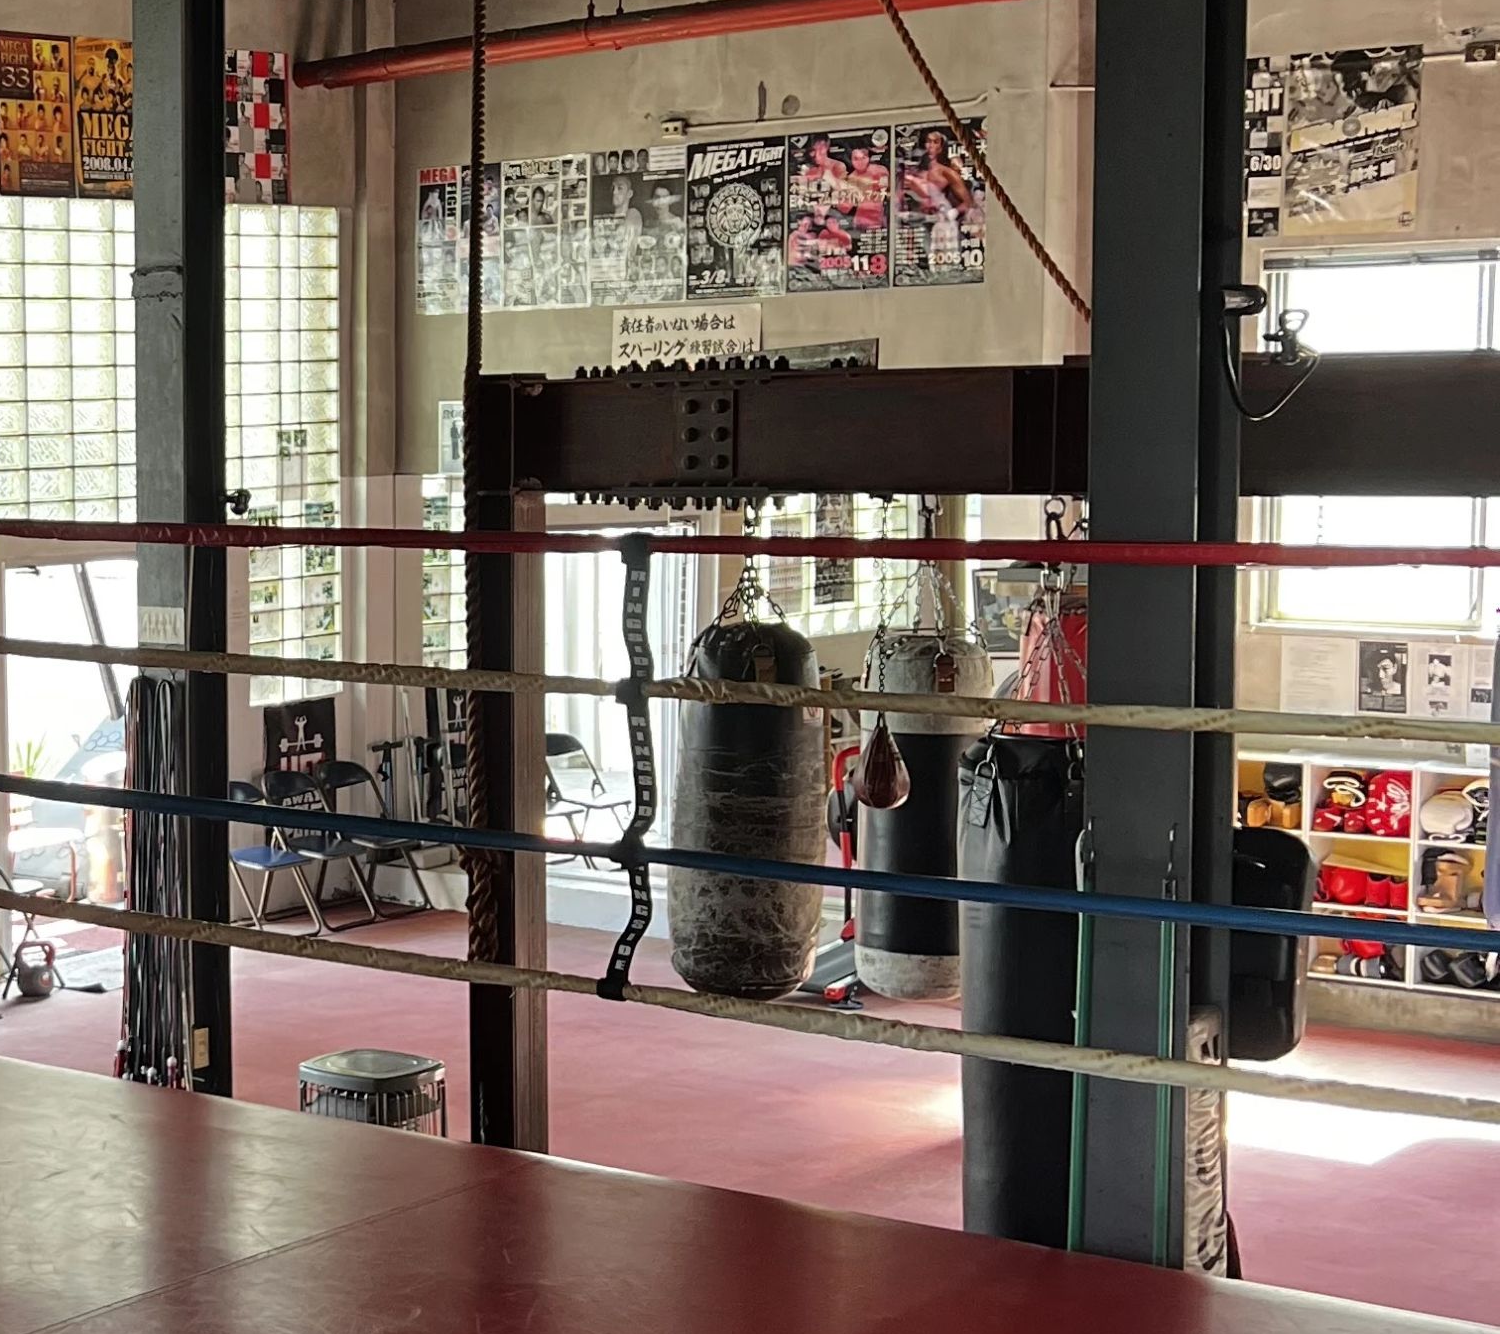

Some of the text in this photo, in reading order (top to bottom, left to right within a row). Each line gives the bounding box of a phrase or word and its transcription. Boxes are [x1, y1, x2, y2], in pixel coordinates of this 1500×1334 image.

[0, 66, 30, 88] 33
[81, 112, 133, 140] MEG
[420, 167, 457, 184] MEGA
[687, 145, 785, 182] MEGA FIGHT
[625, 570, 650, 678] RINGSIDE
[613, 866, 650, 972] INGSIDE
